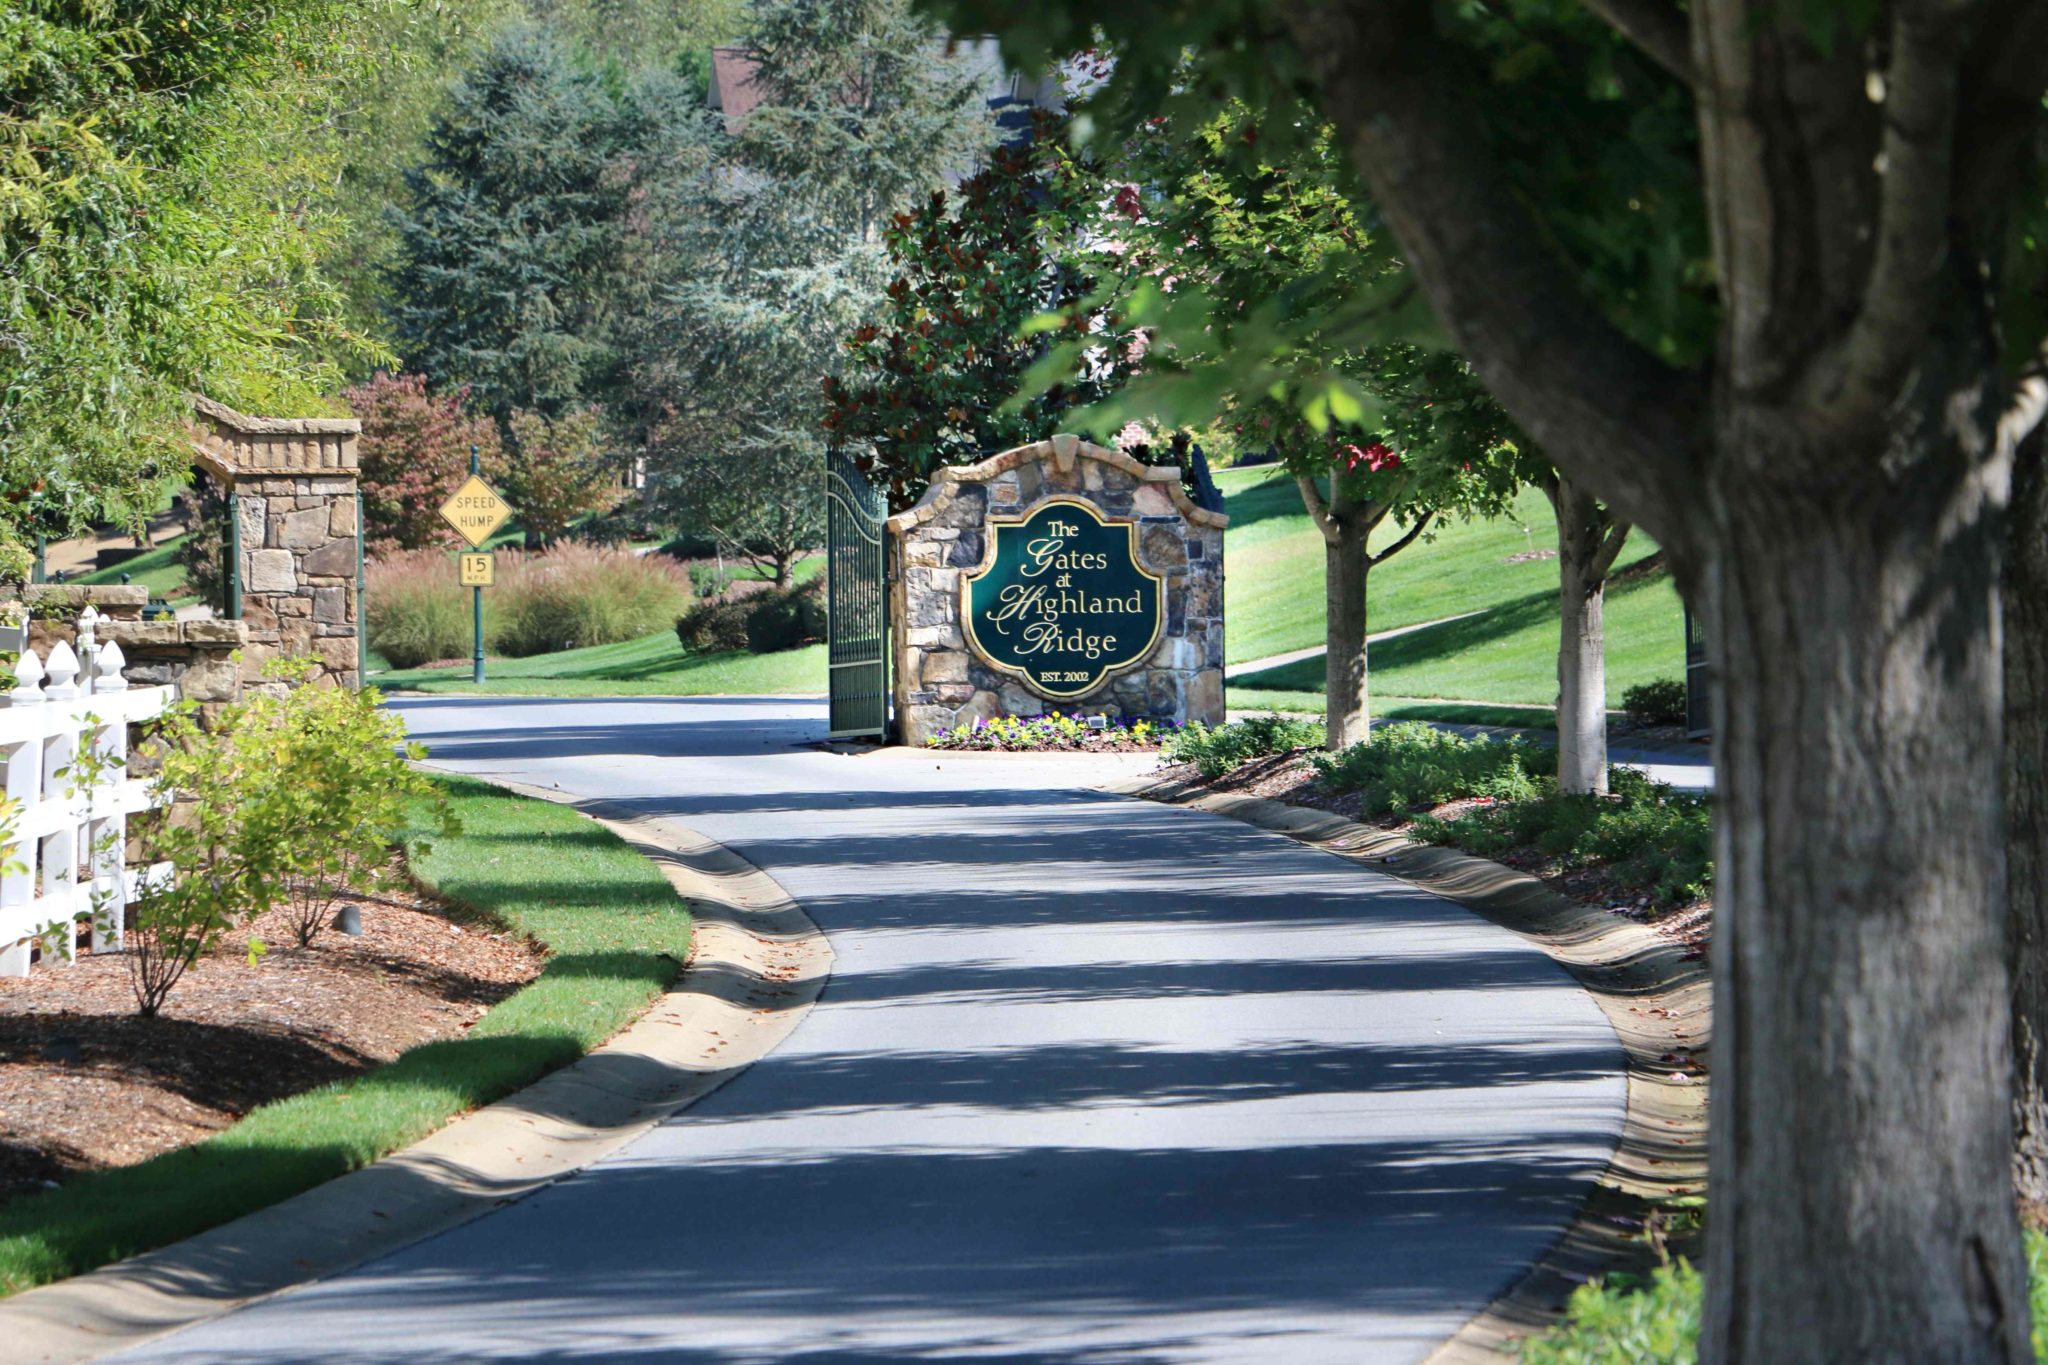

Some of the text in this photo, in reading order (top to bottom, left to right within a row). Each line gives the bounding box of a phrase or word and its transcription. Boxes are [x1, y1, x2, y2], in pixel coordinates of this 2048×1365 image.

[456, 497, 496, 509] SPEED
[460, 516, 494, 528] HUMP
[1048, 521, 1079, 537] The
[467, 557, 487, 573] 15
[1020, 538, 1107, 577] Gates
[1056, 573, 1072, 588] at
[986, 585, 1143, 635] Highland
[1014, 621, 1117, 660] Ridge
[1040, 671, 1089, 682] EST. 2002
